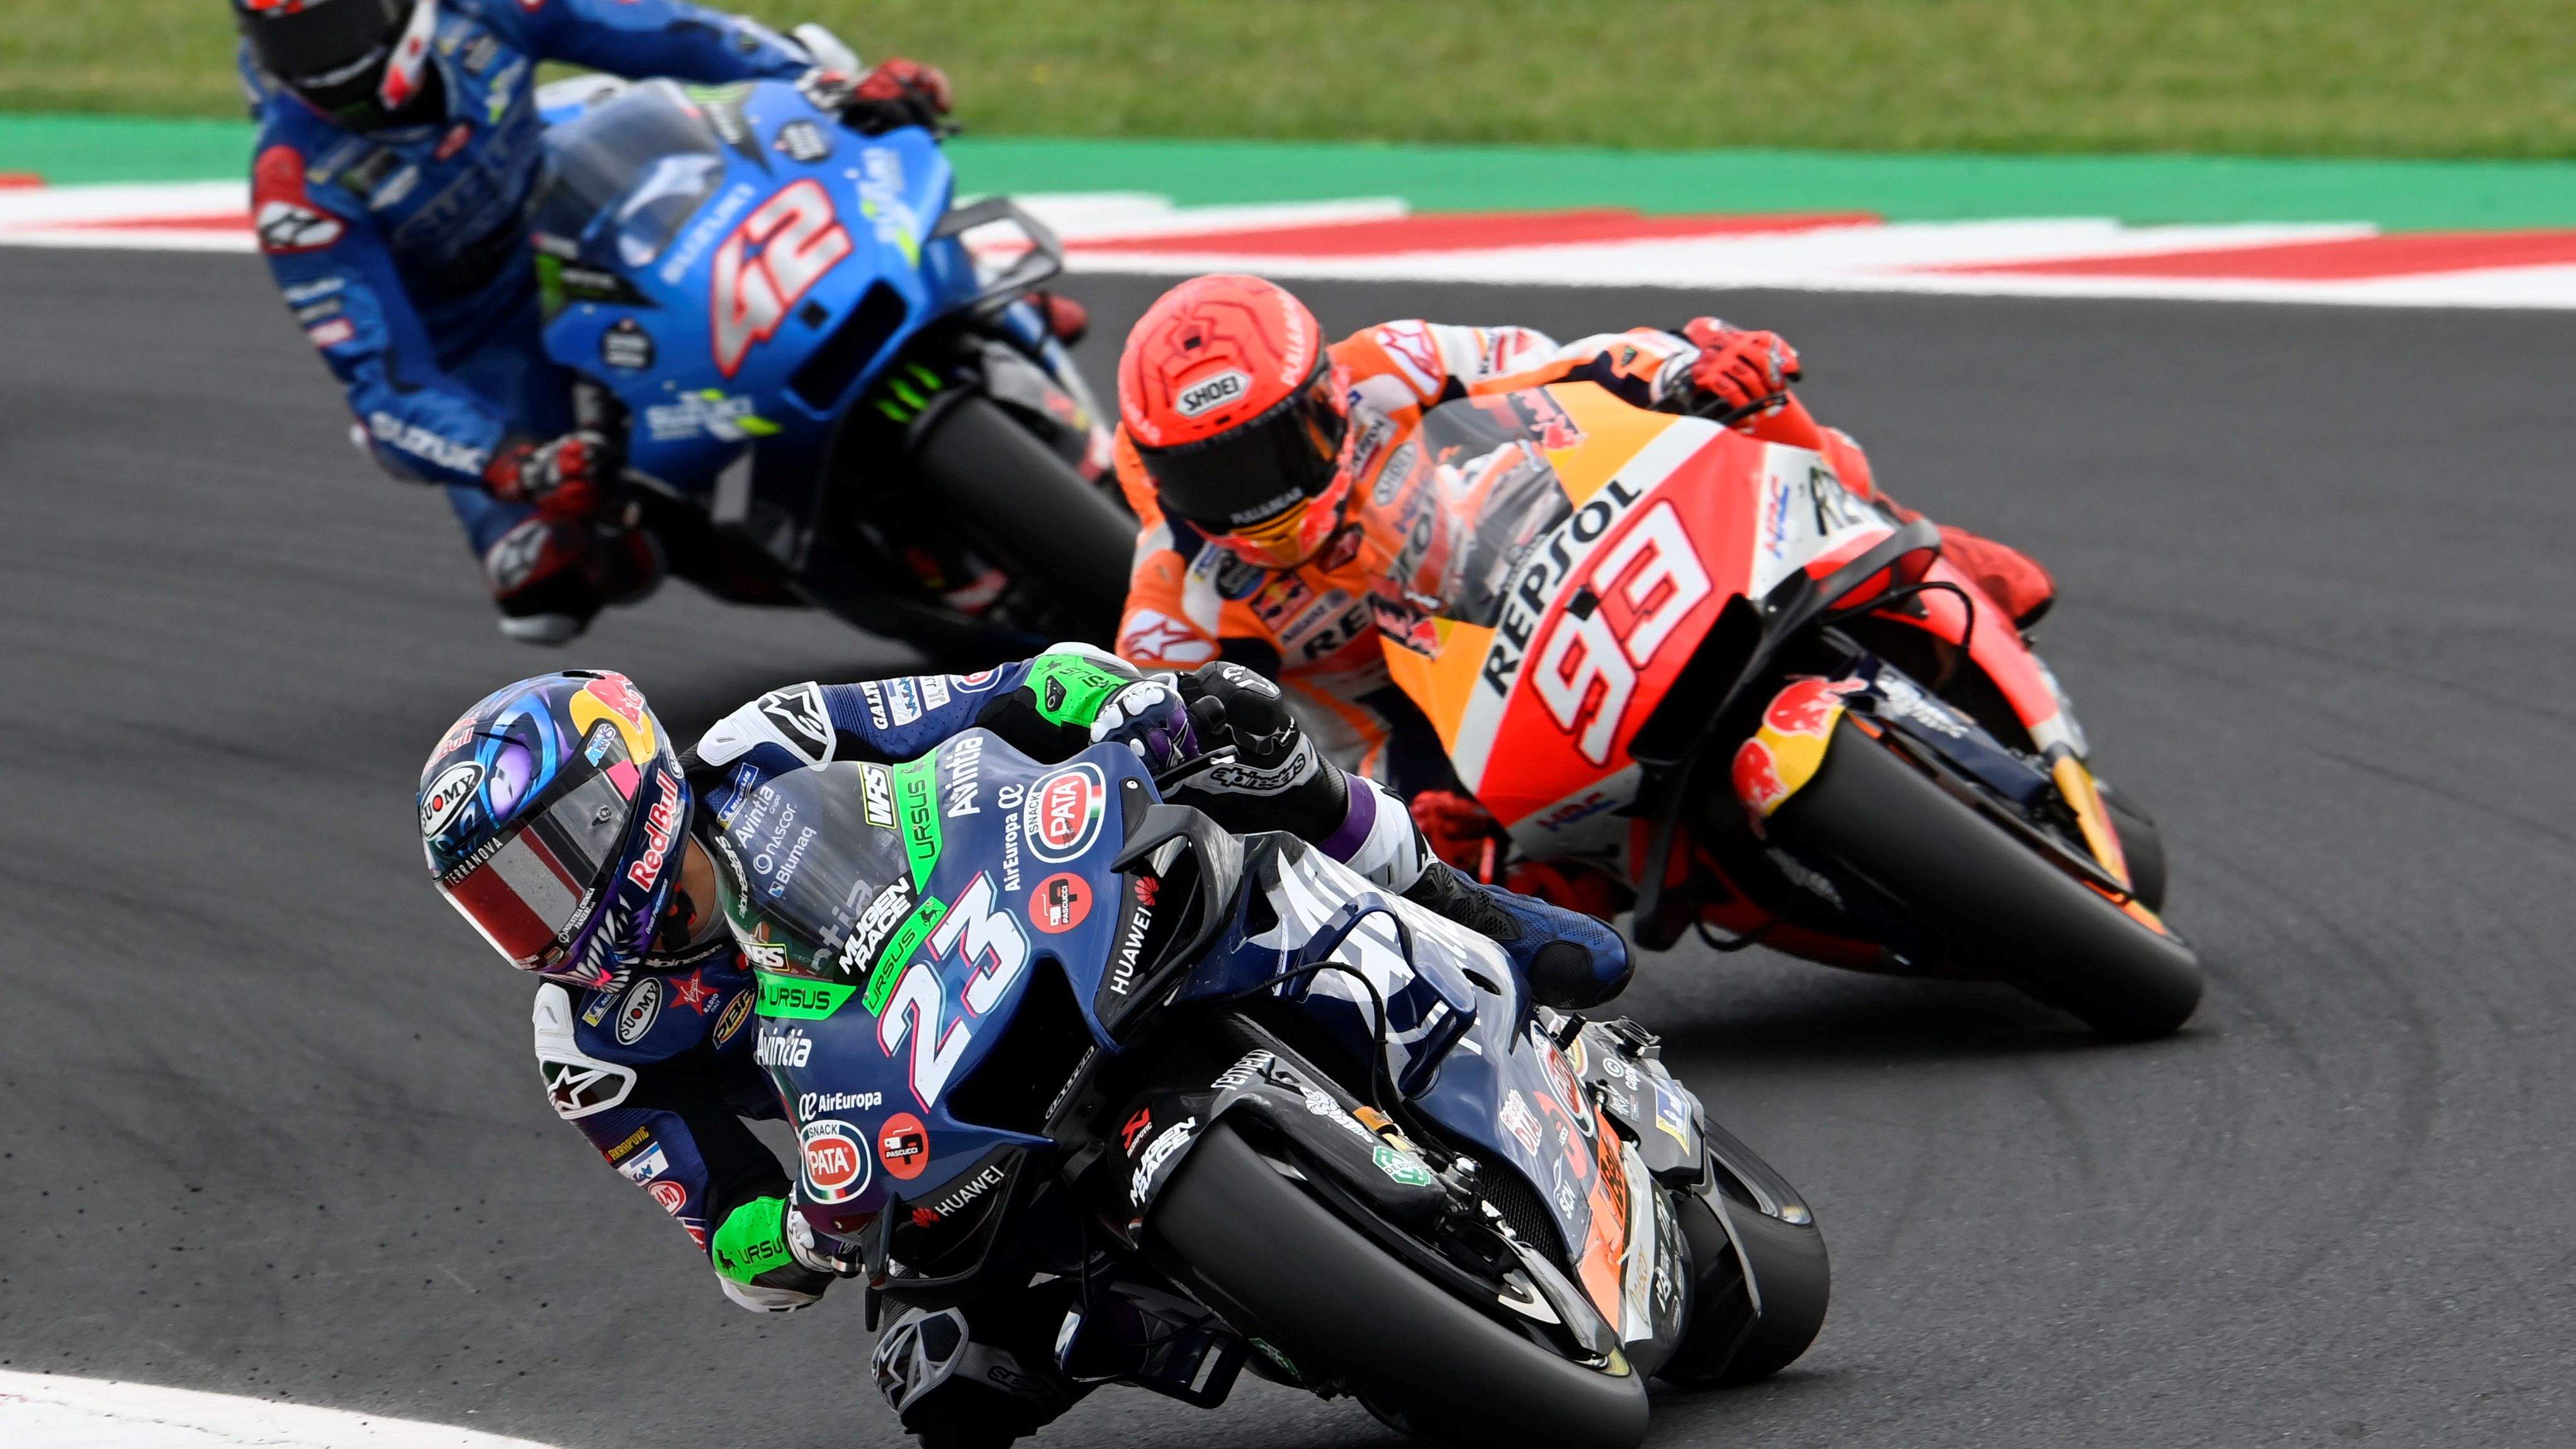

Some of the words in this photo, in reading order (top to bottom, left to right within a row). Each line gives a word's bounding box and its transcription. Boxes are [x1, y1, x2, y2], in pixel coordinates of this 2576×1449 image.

[711, 178, 855, 378] 42
[1183, 376, 1239, 410] SHOEI
[1483, 480, 1642, 698] REPSOL
[1530, 497, 1714, 767] 93
[861, 765, 892, 825] WRS
[945, 736, 984, 818] Avintia
[1209, 752, 1306, 790] alpinestars
[734, 785, 775, 849] Avintia
[769, 794, 781, 815] Grupo
[908, 779, 936, 859] URSUS
[1028, 792, 1040, 833] SNACK
[1050, 780, 1079, 838] PATA
[444, 837, 503, 886] TERRANOVA
[775, 825, 818, 884] Blumaq
[1003, 813, 1021, 892] AirEuropa
[562, 908, 582, 933] INDUSTRIA
[579, 887, 595, 910] CHIMICA
[838, 876, 911, 975] MUGEN
[854, 894, 912, 973] RACE
[868, 928, 916, 1011] URSUS
[1110, 906, 1152, 995] HUAWEI
[680, 978, 704, 1003] Virgin
[702, 993, 719, 1014] RADIO
[711, 1000, 721, 1013] ITALY
[769, 986, 831, 1010] URSUS
[877, 870, 1031, 1114] 23
[756, 1027, 812, 1068] Avintia
[818, 1091, 882, 1114] AirEuropa
[809, 1124, 838, 1138] SNACK
[886, 1147, 918, 1158] PASCUCCI
[809, 1147, 850, 1176] PATA
[1130, 1116, 1196, 1208] MUGEN
[1138, 1129, 1191, 1204] RACE
[935, 1165, 1006, 1217] HUAWEI
[738, 1236, 784, 1265] URSU
